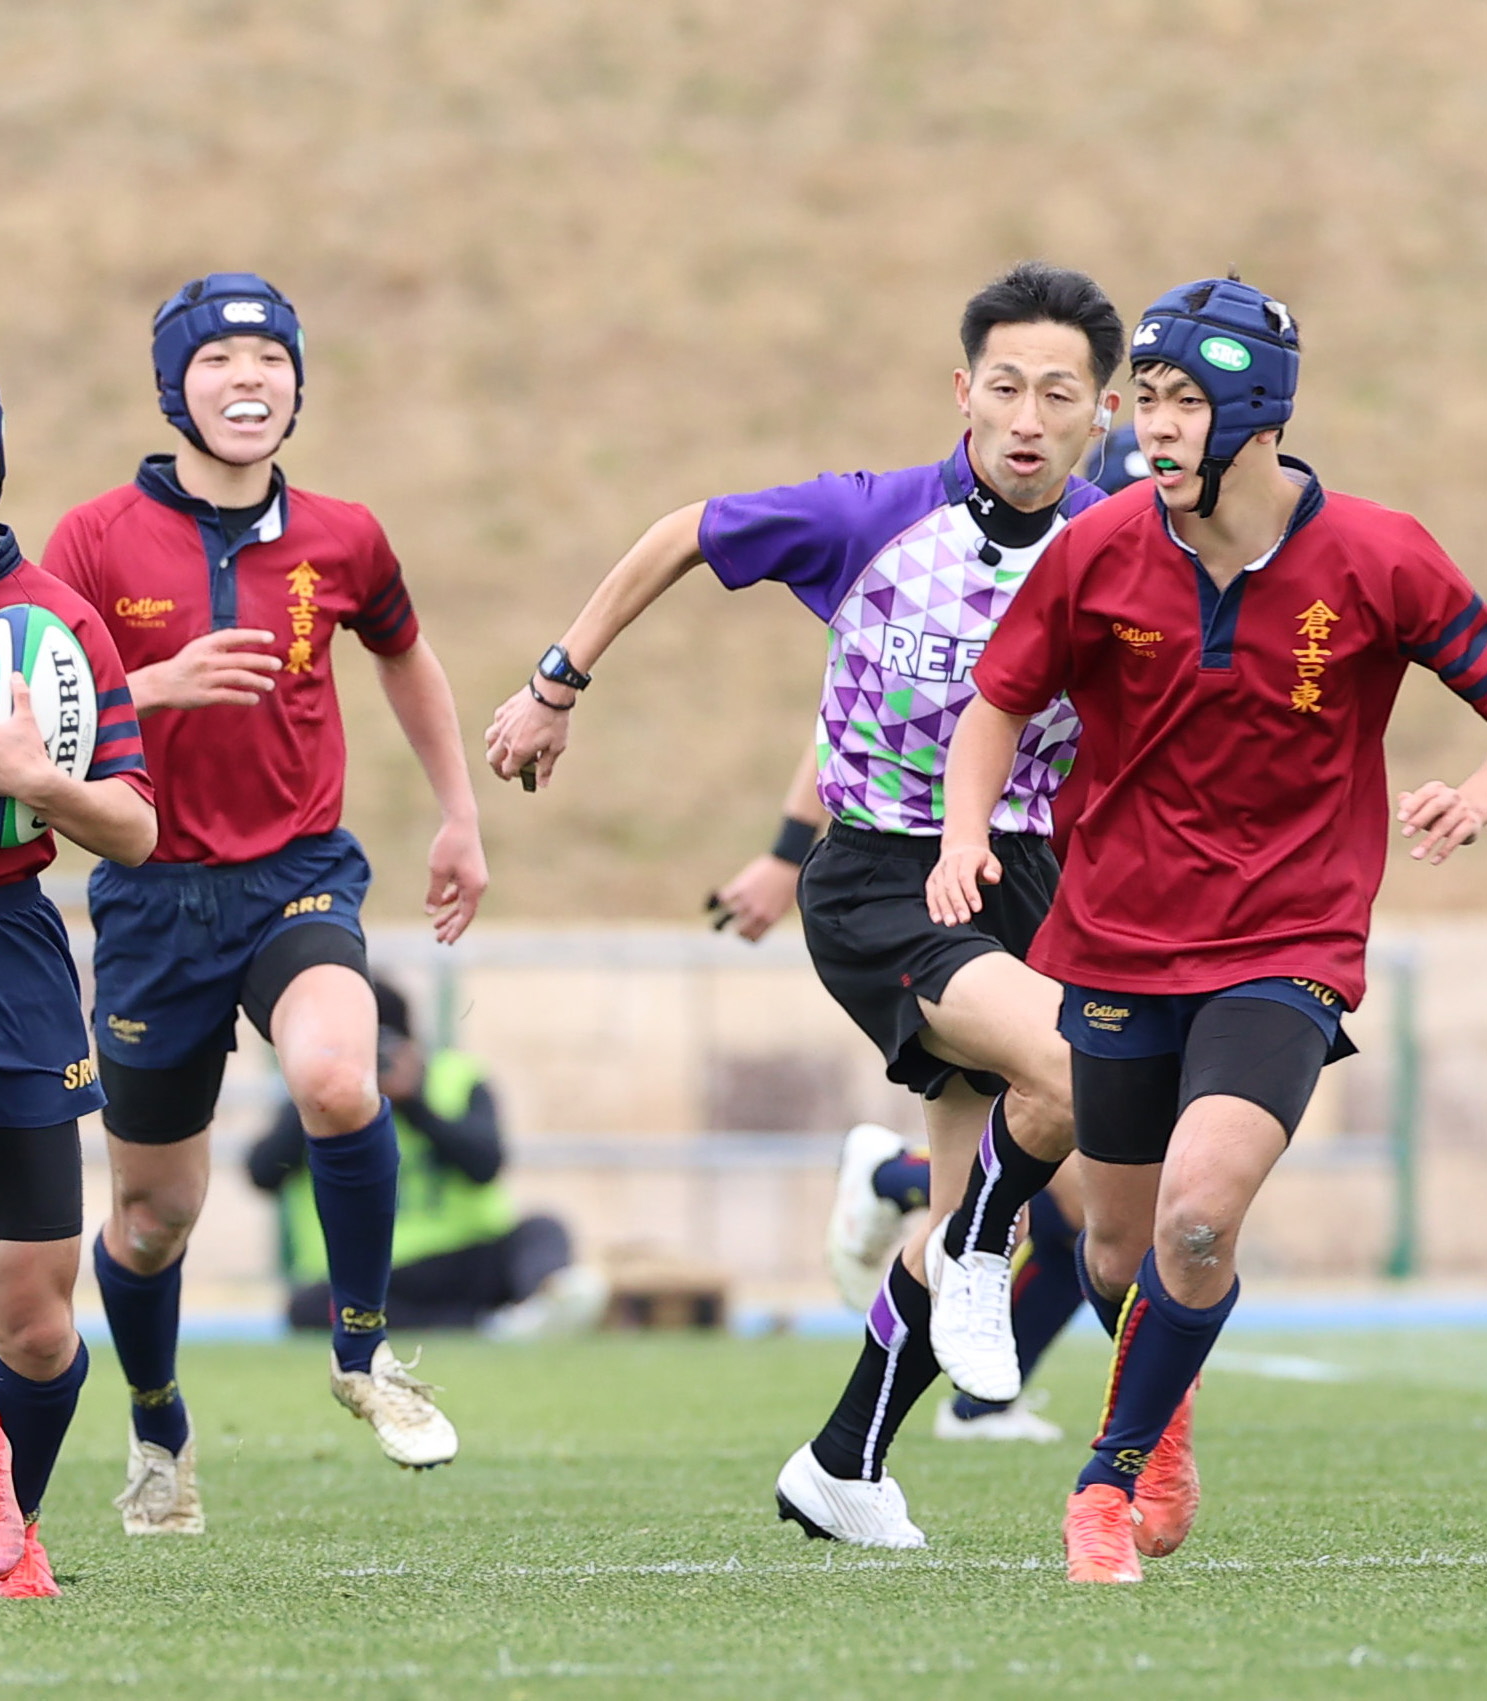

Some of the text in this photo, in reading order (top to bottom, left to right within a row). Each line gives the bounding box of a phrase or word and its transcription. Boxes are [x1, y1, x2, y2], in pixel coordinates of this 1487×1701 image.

[115, 596, 175, 618] Cotton
[284, 559, 322, 675] 倉吉東
[1112, 622, 1165, 643] Cotton
[1288, 599, 1341, 713] 倉吉東
[1083, 1001, 1130, 1018] Cotton
[63, 1058, 95, 1090] SR
